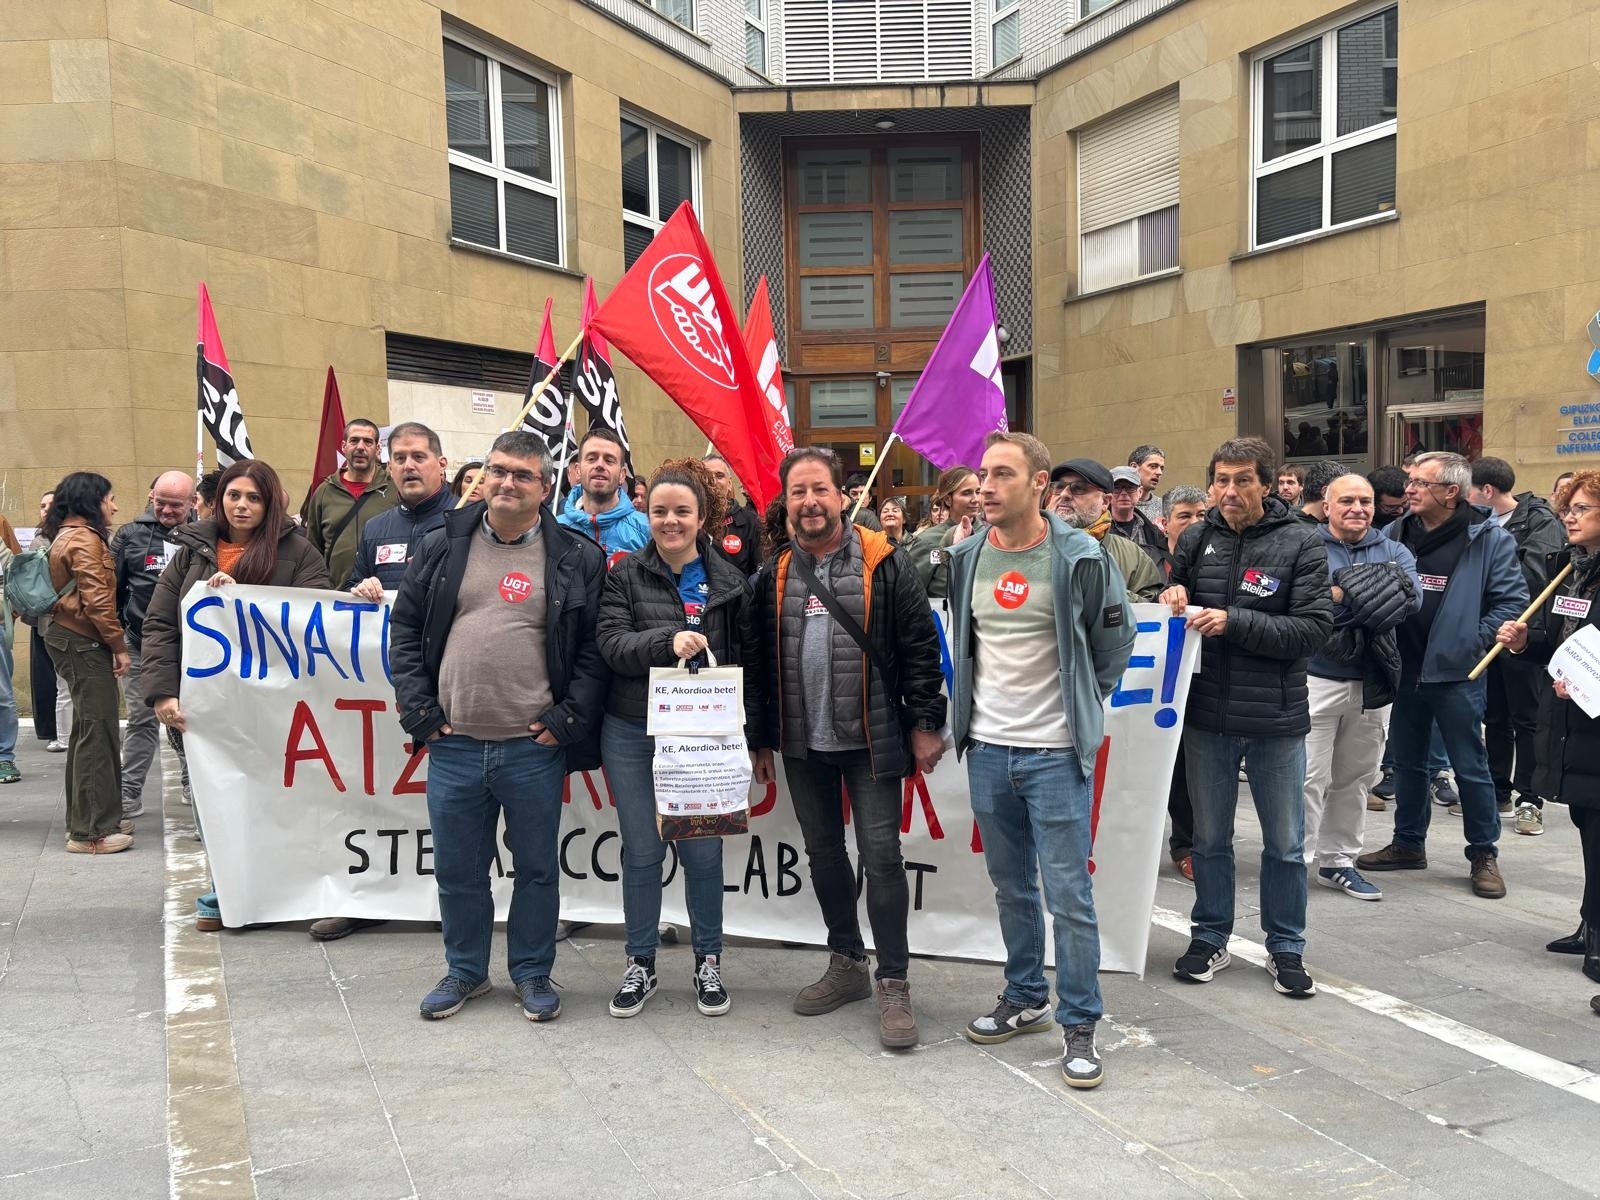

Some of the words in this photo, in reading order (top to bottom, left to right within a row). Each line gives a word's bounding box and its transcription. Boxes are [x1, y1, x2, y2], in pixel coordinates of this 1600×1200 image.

[878, 345, 889, 362] 2
[1573, 415, 1600, 425] ELKA
[503, 575, 531, 592] UGT
[1564, 600, 1587, 611] CCOO
[186, 595, 394, 686] SINAT
[655, 686, 669, 694] KE,
[671, 686, 712, 694] Akordioa
[714, 686, 736, 694] bete!
[662, 745, 677, 753] KE,
[679, 743, 720, 752] Akordioa
[721, 743, 743, 751] bete!
